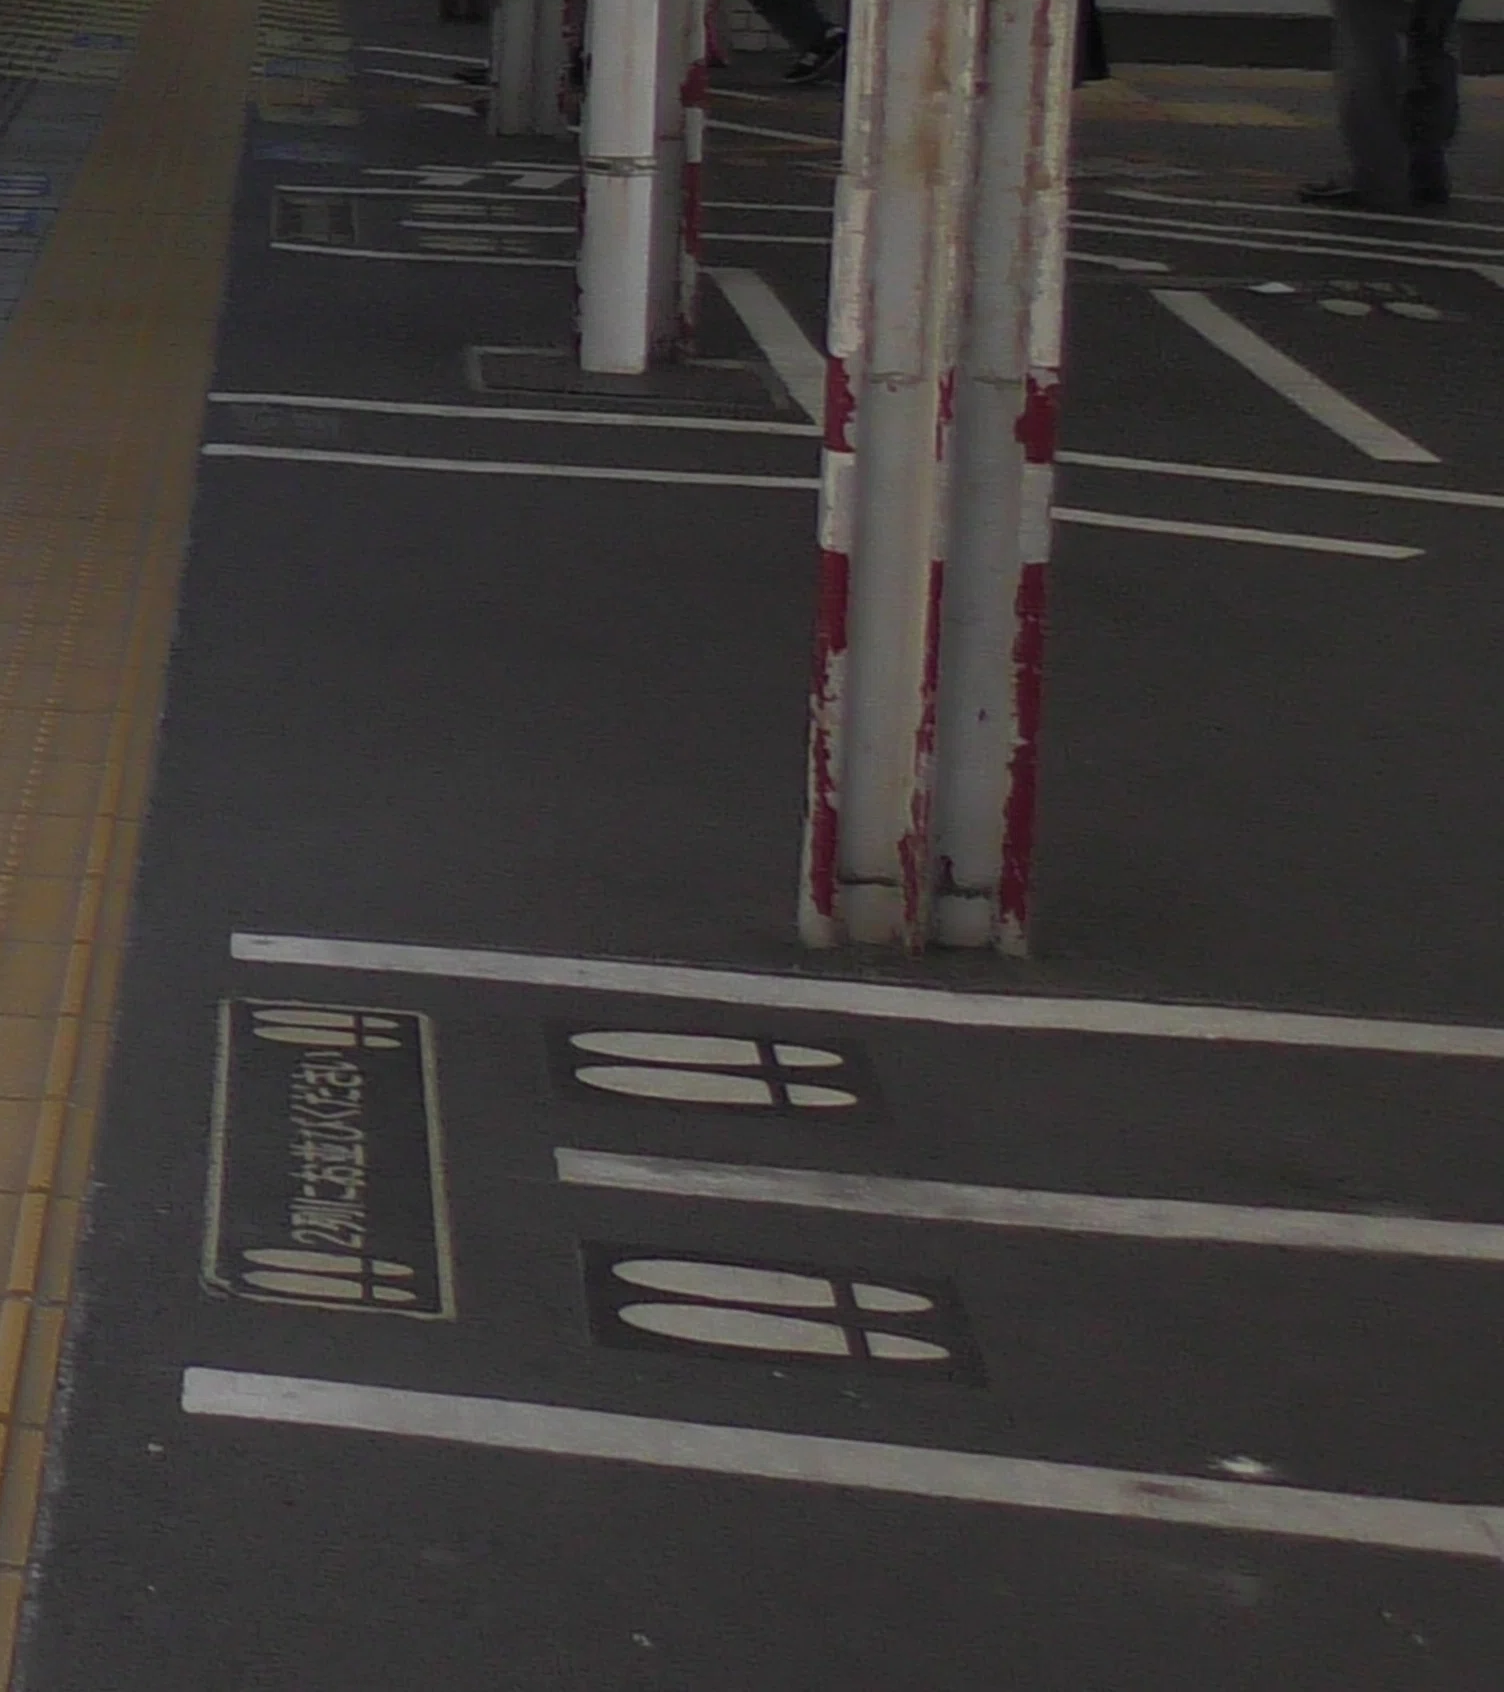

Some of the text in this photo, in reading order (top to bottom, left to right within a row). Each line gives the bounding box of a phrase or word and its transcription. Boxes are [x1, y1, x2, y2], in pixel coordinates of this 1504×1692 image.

[288, 1050, 367, 1249] 2列にお並びください
